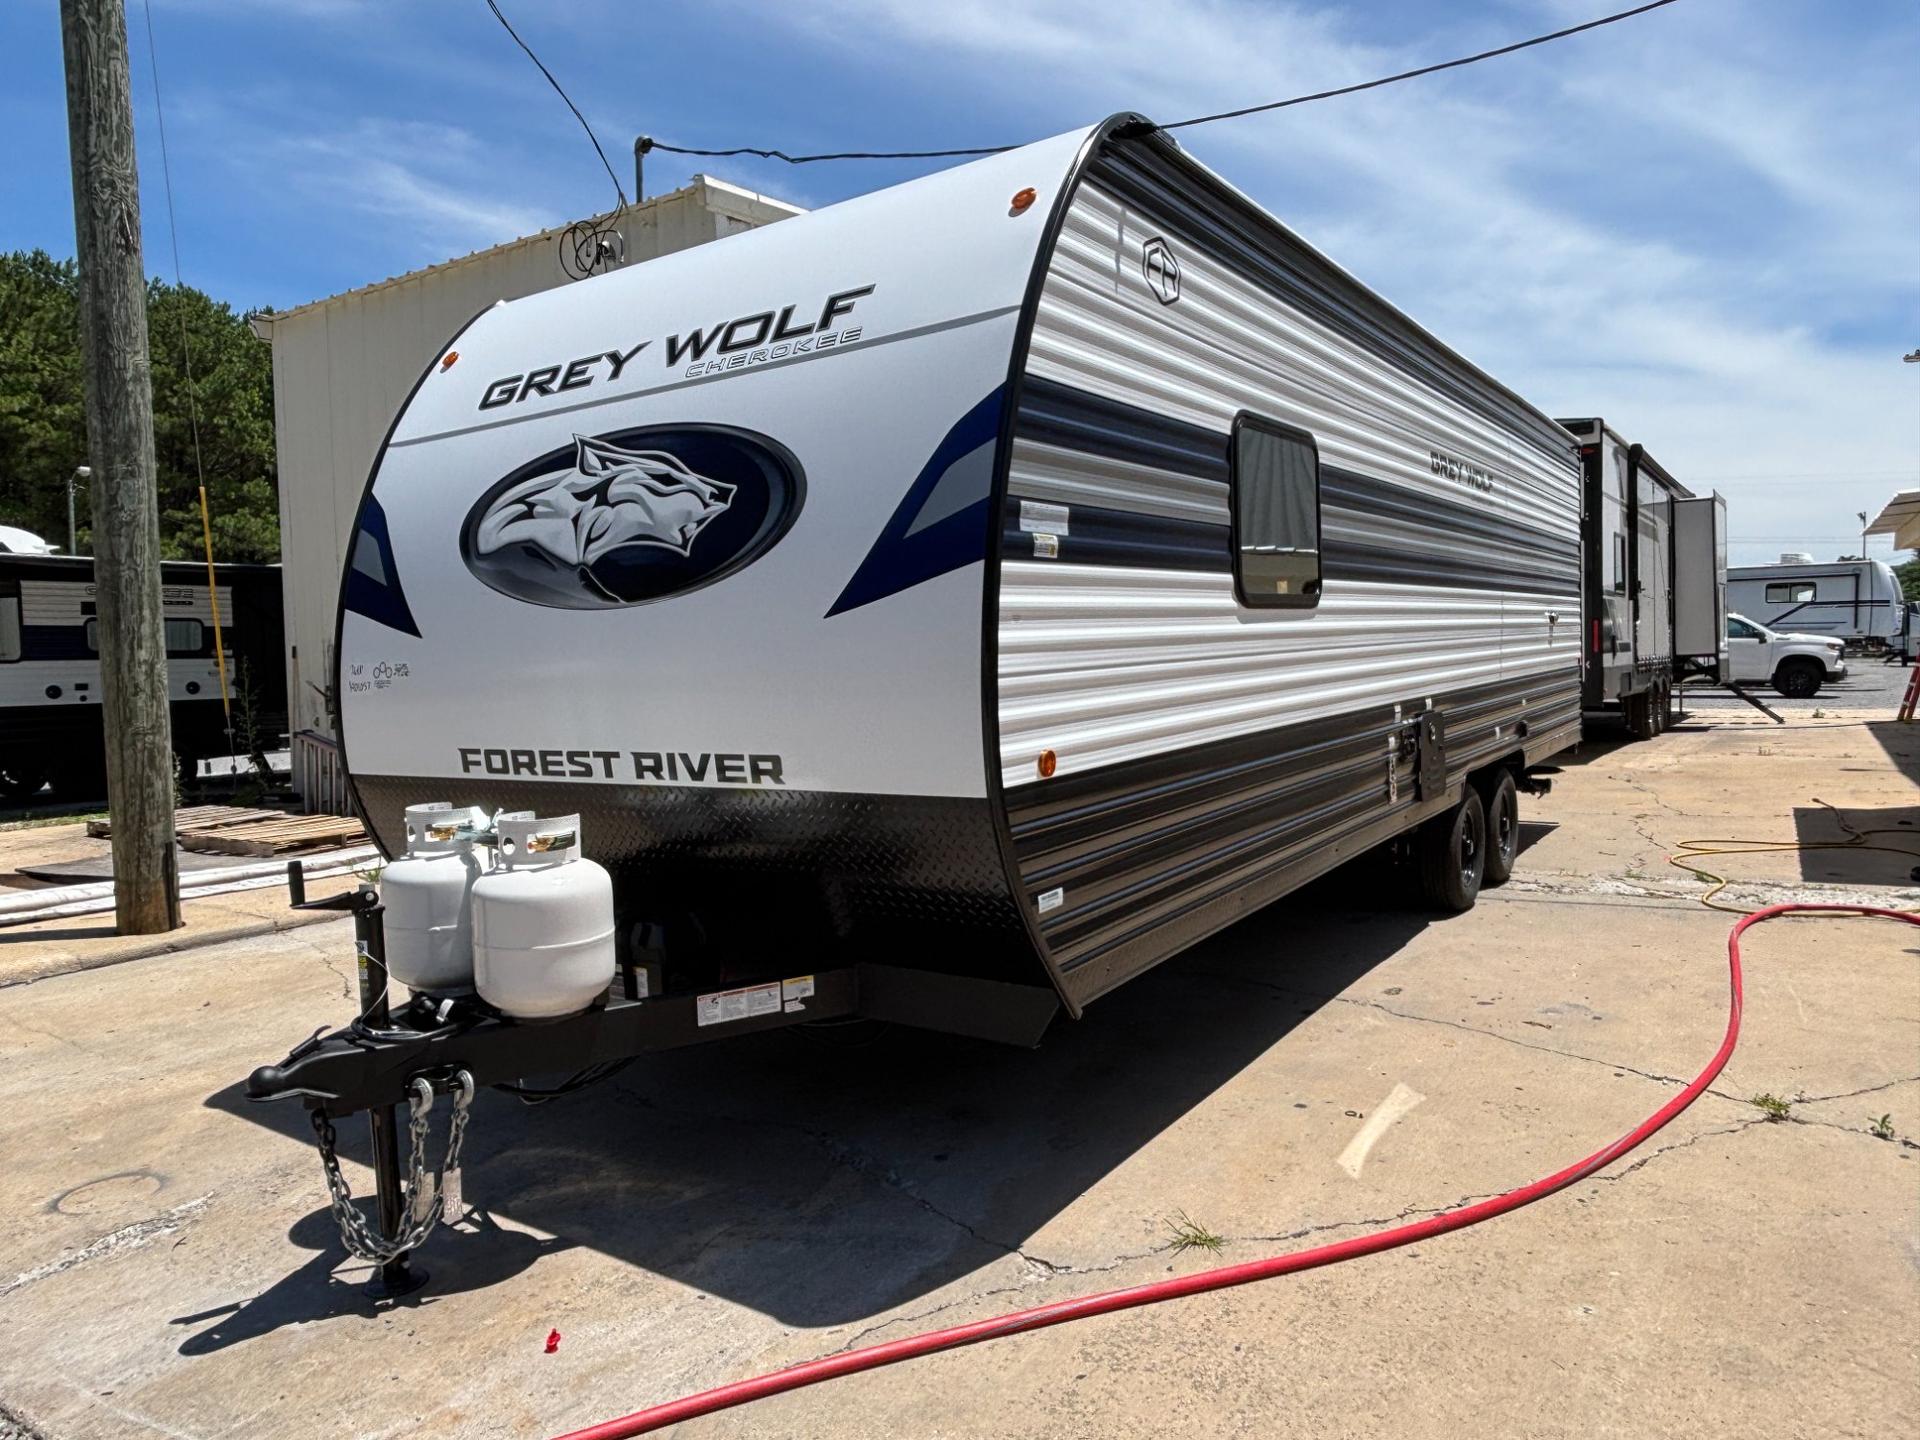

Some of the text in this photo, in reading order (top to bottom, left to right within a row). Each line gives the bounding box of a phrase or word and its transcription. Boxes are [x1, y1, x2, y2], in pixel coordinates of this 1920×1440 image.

[478, 284, 876, 410] GREY WOLF
[685, 326, 862, 378] CHEROKEE
[1430, 451, 1494, 493] GREY WOLF
[457, 748, 786, 784] FOREST RIVER
